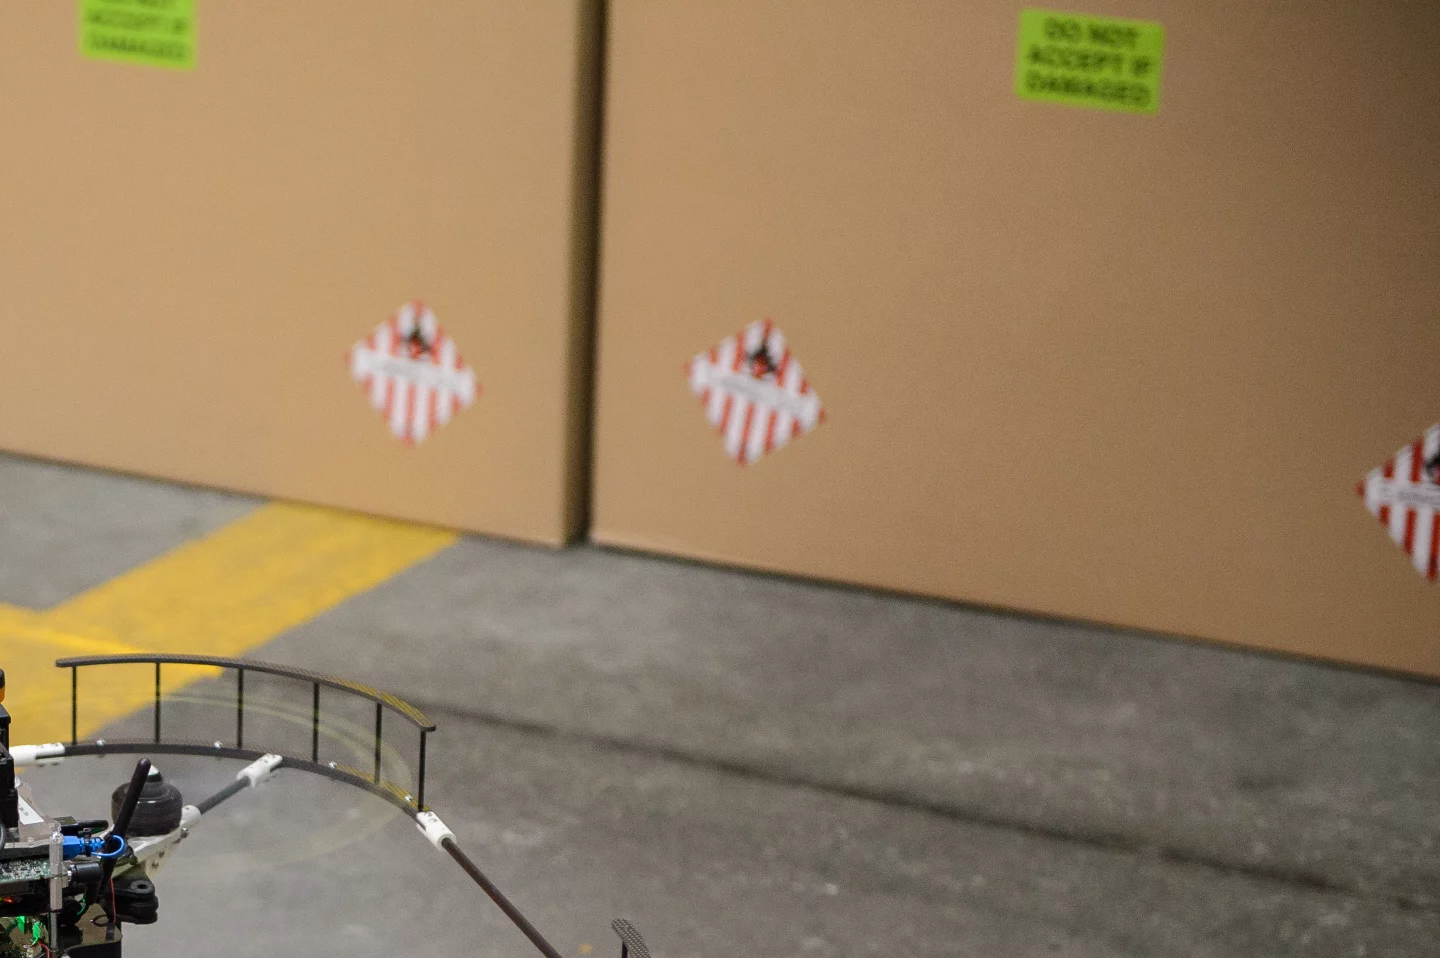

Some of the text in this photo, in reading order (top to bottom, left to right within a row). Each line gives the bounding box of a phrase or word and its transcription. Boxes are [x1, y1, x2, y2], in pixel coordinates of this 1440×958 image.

[1044, 15, 1139, 49] DO NOT
[1027, 43, 1153, 78] ACCEPT IF
[1025, 67, 1152, 107] DAMAGED
